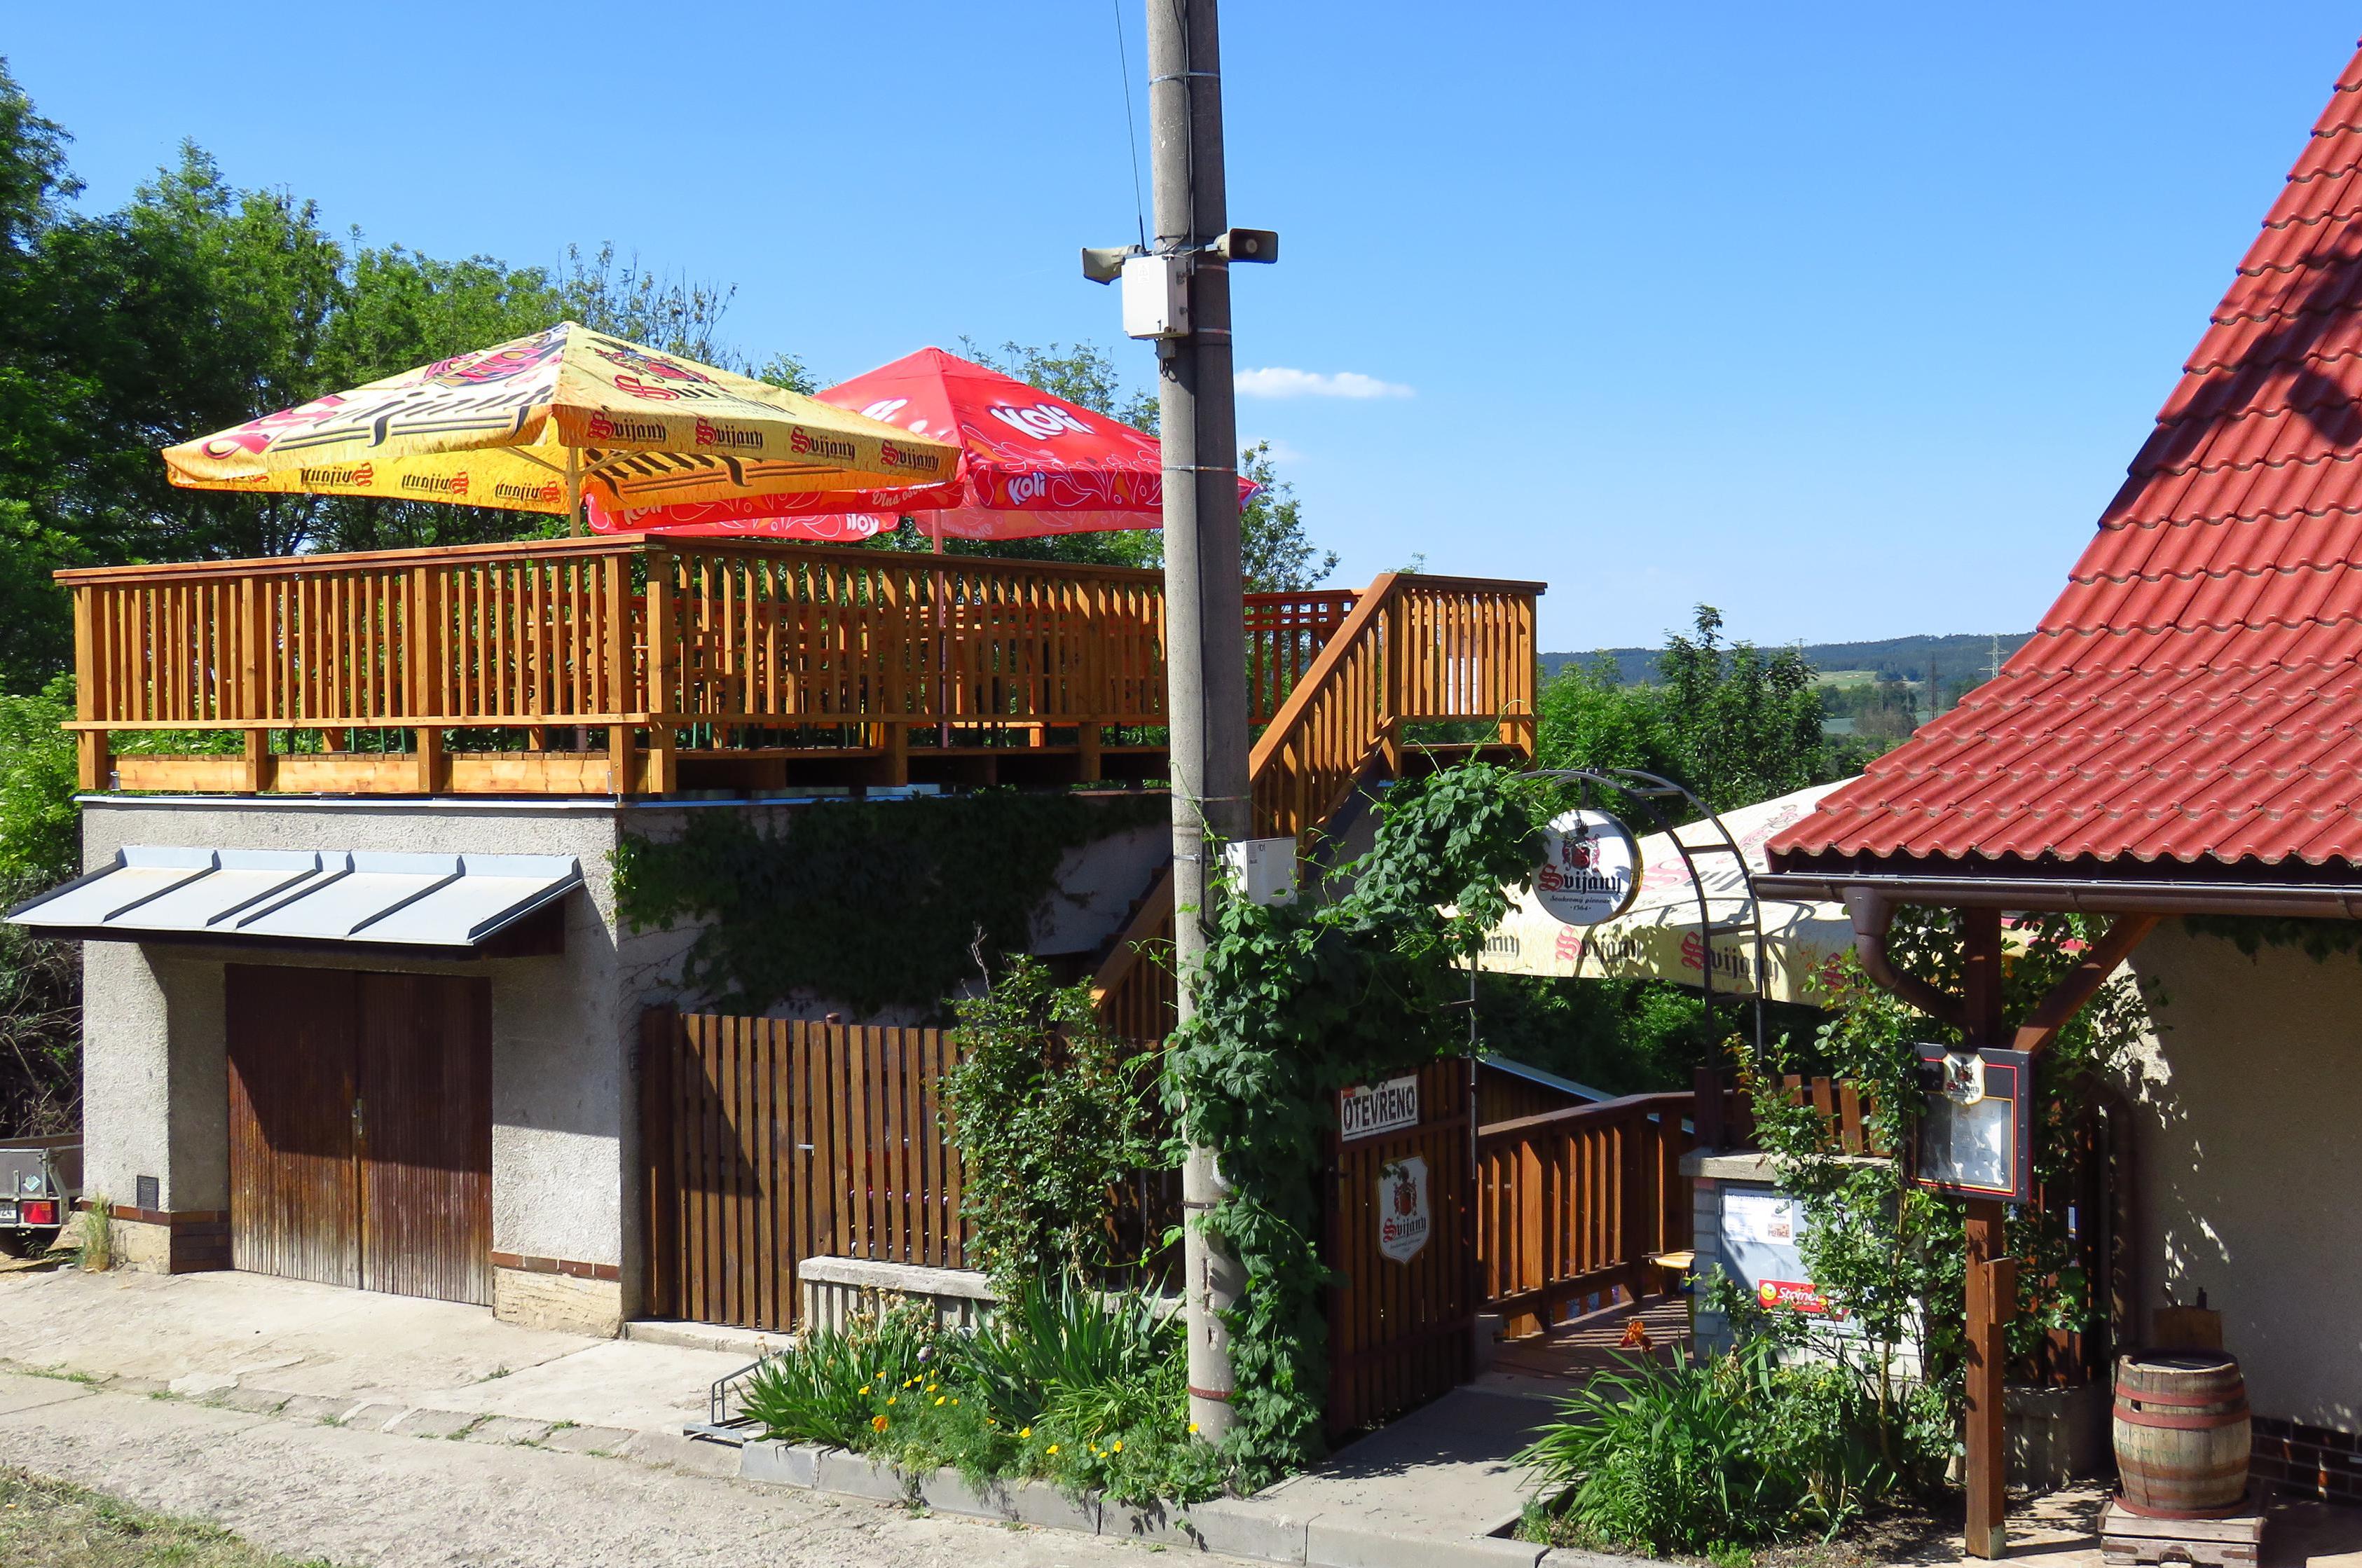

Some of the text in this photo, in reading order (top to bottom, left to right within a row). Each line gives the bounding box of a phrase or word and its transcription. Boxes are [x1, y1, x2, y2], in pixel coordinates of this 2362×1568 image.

[1157, 319, 1162, 331] 1
[589, 411, 666, 443] Svijany
[695, 417, 763, 449] Svijany
[990, 404, 1095, 440] Koli
[790, 426, 856, 462] Svijany
[881, 439, 939, 472] Svijany
[1008, 472, 1046, 506] Koli
[1538, 863, 1621, 895] Svijany
[1343, 1084, 1415, 1130] OTEVŘENO
[1383, 1216, 1427, 1242] Svijany
